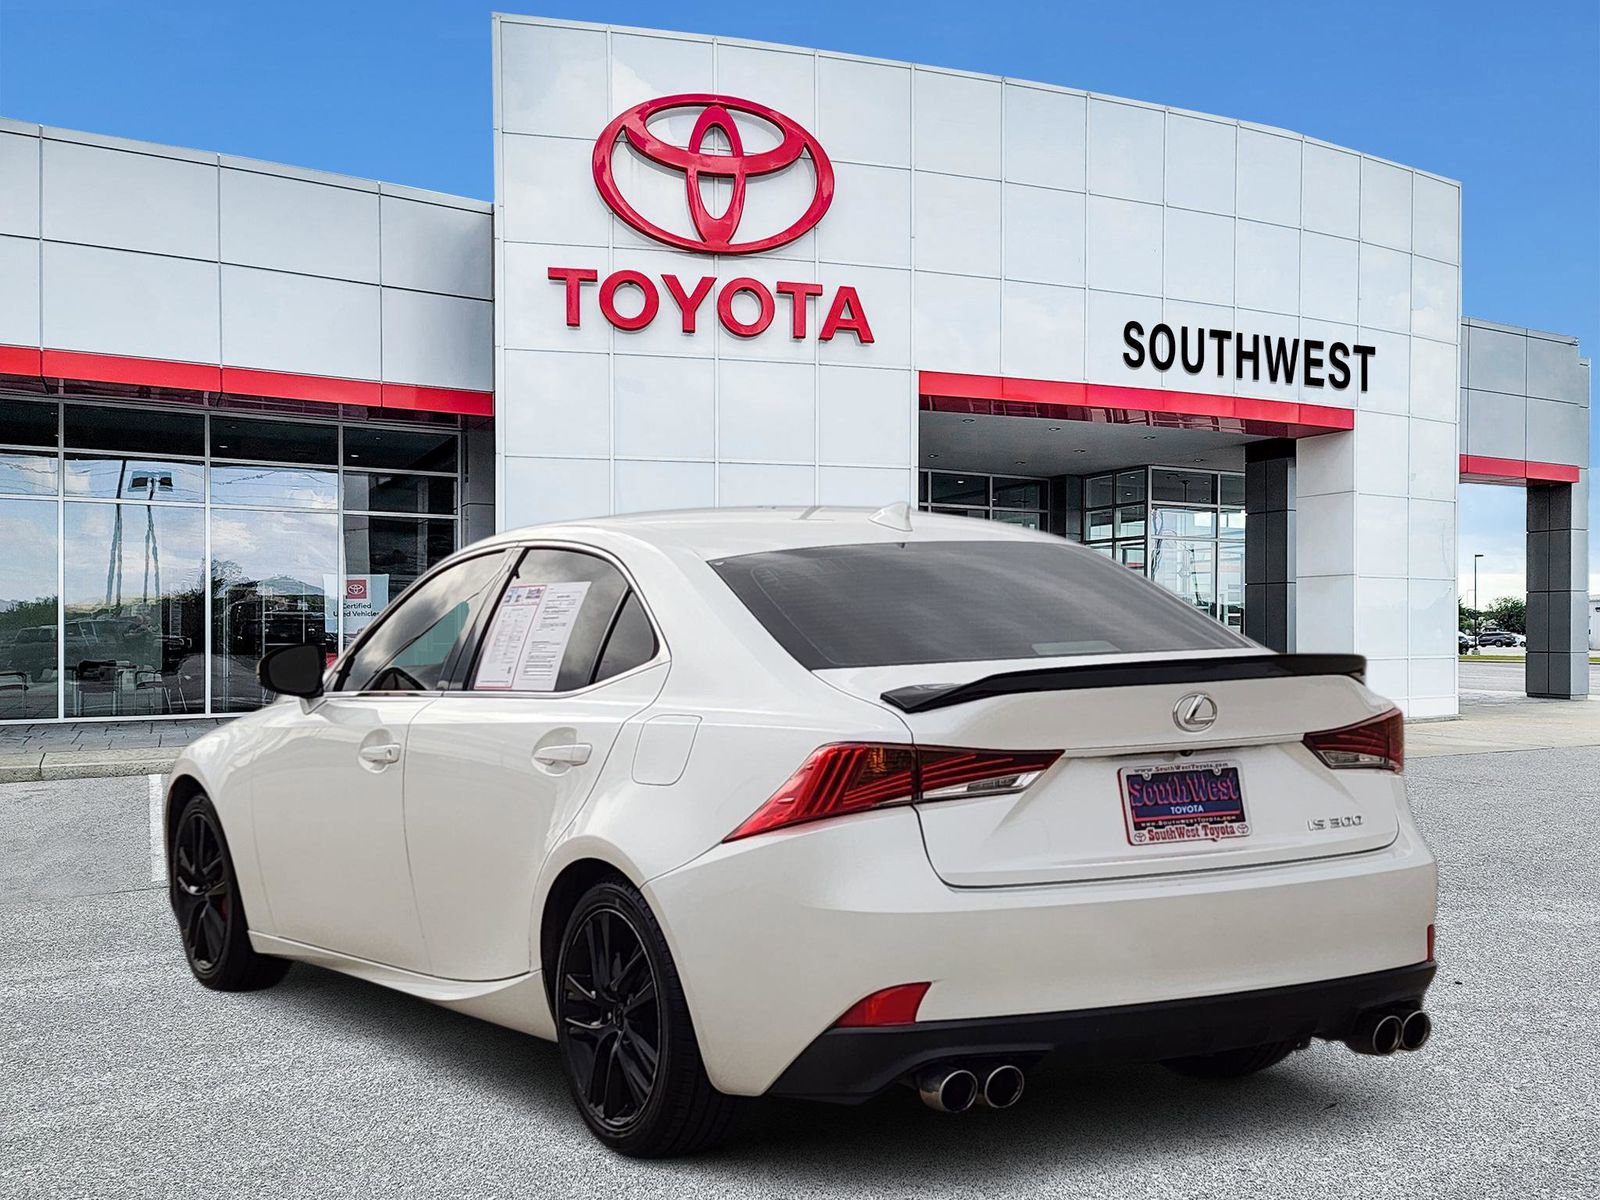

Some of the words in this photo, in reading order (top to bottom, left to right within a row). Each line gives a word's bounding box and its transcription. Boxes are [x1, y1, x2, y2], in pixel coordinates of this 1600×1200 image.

[547, 266, 875, 344] TOYOTA
[1122, 320, 1376, 393] SOUTHWEST
[1170, 804, 1204, 815] TOYOTA
[1201, 823, 1236, 839] Toyota
[1307, 819, 1326, 832] IS
[1328, 815, 1364, 829] 300
